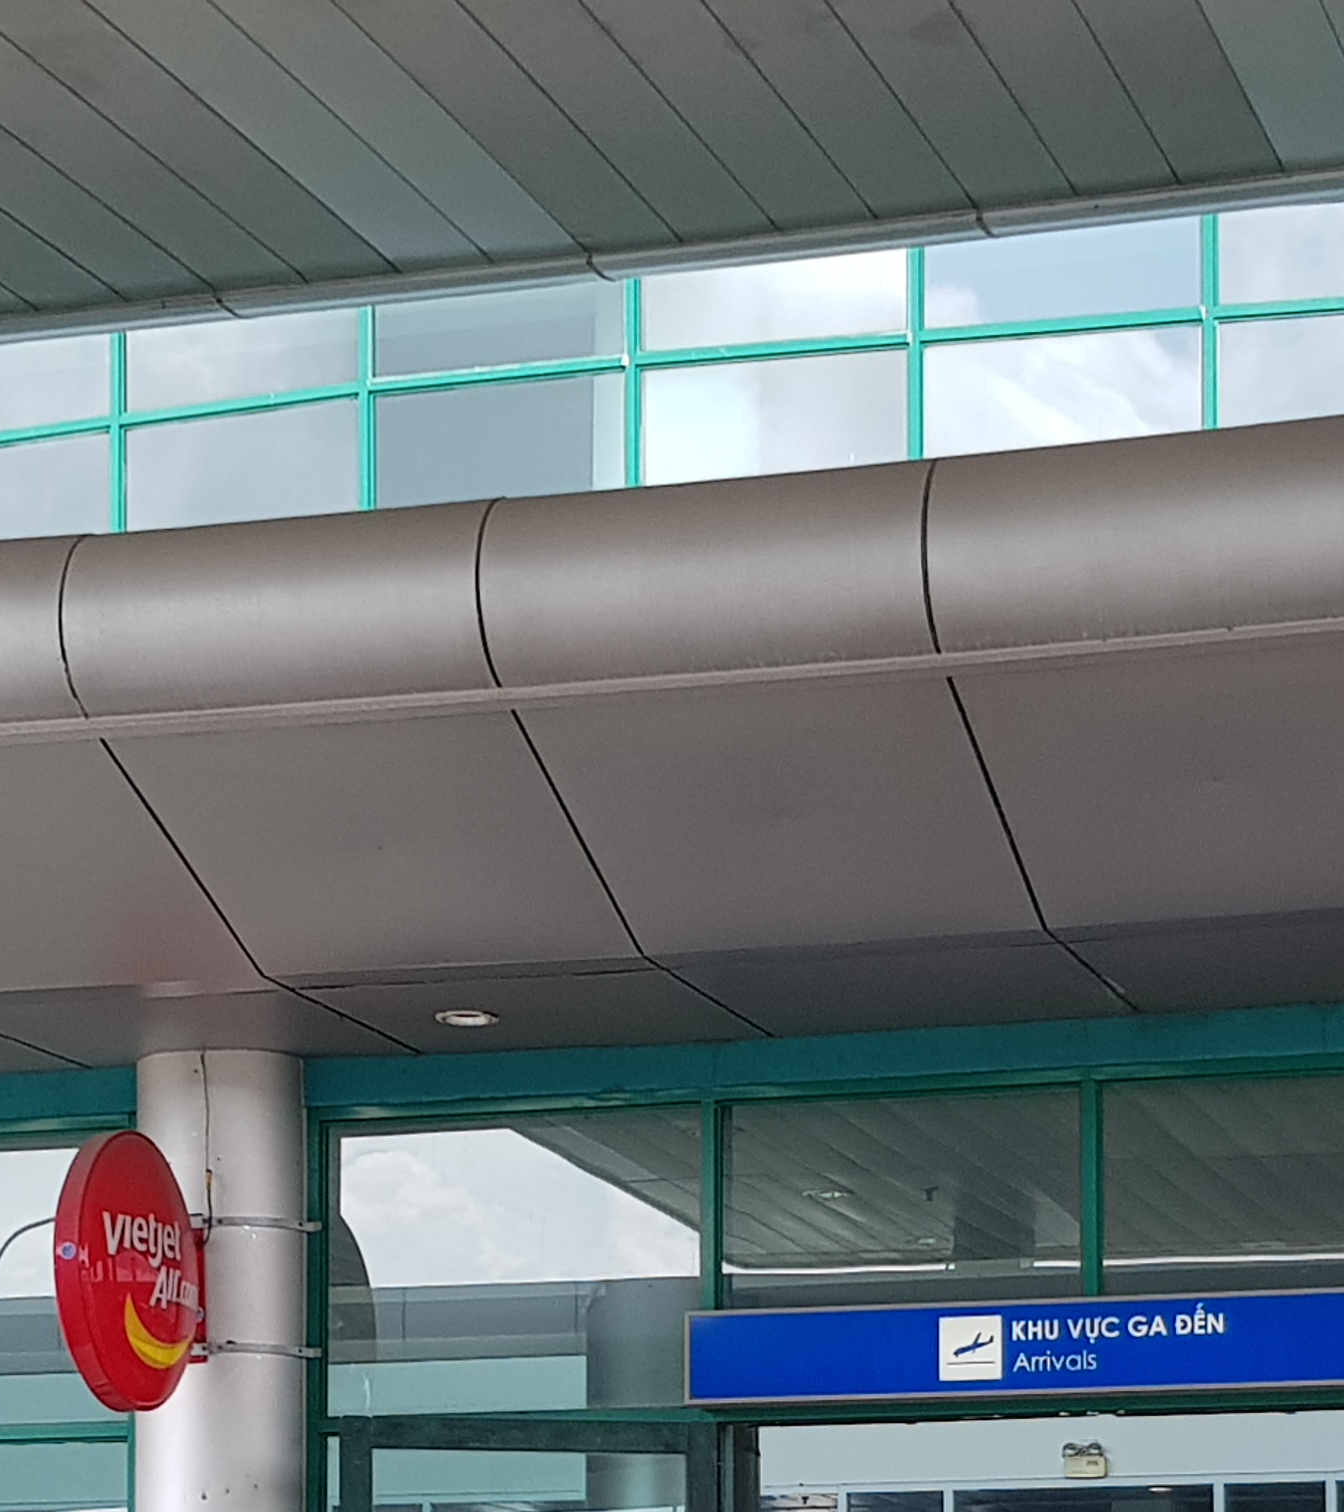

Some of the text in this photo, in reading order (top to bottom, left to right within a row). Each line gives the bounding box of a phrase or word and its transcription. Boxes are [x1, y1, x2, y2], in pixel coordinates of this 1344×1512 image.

[1011, 1302, 1225, 1344] KHU VỰC GA ĐẾN
[1012, 1350, 1098, 1373] Arrivals
